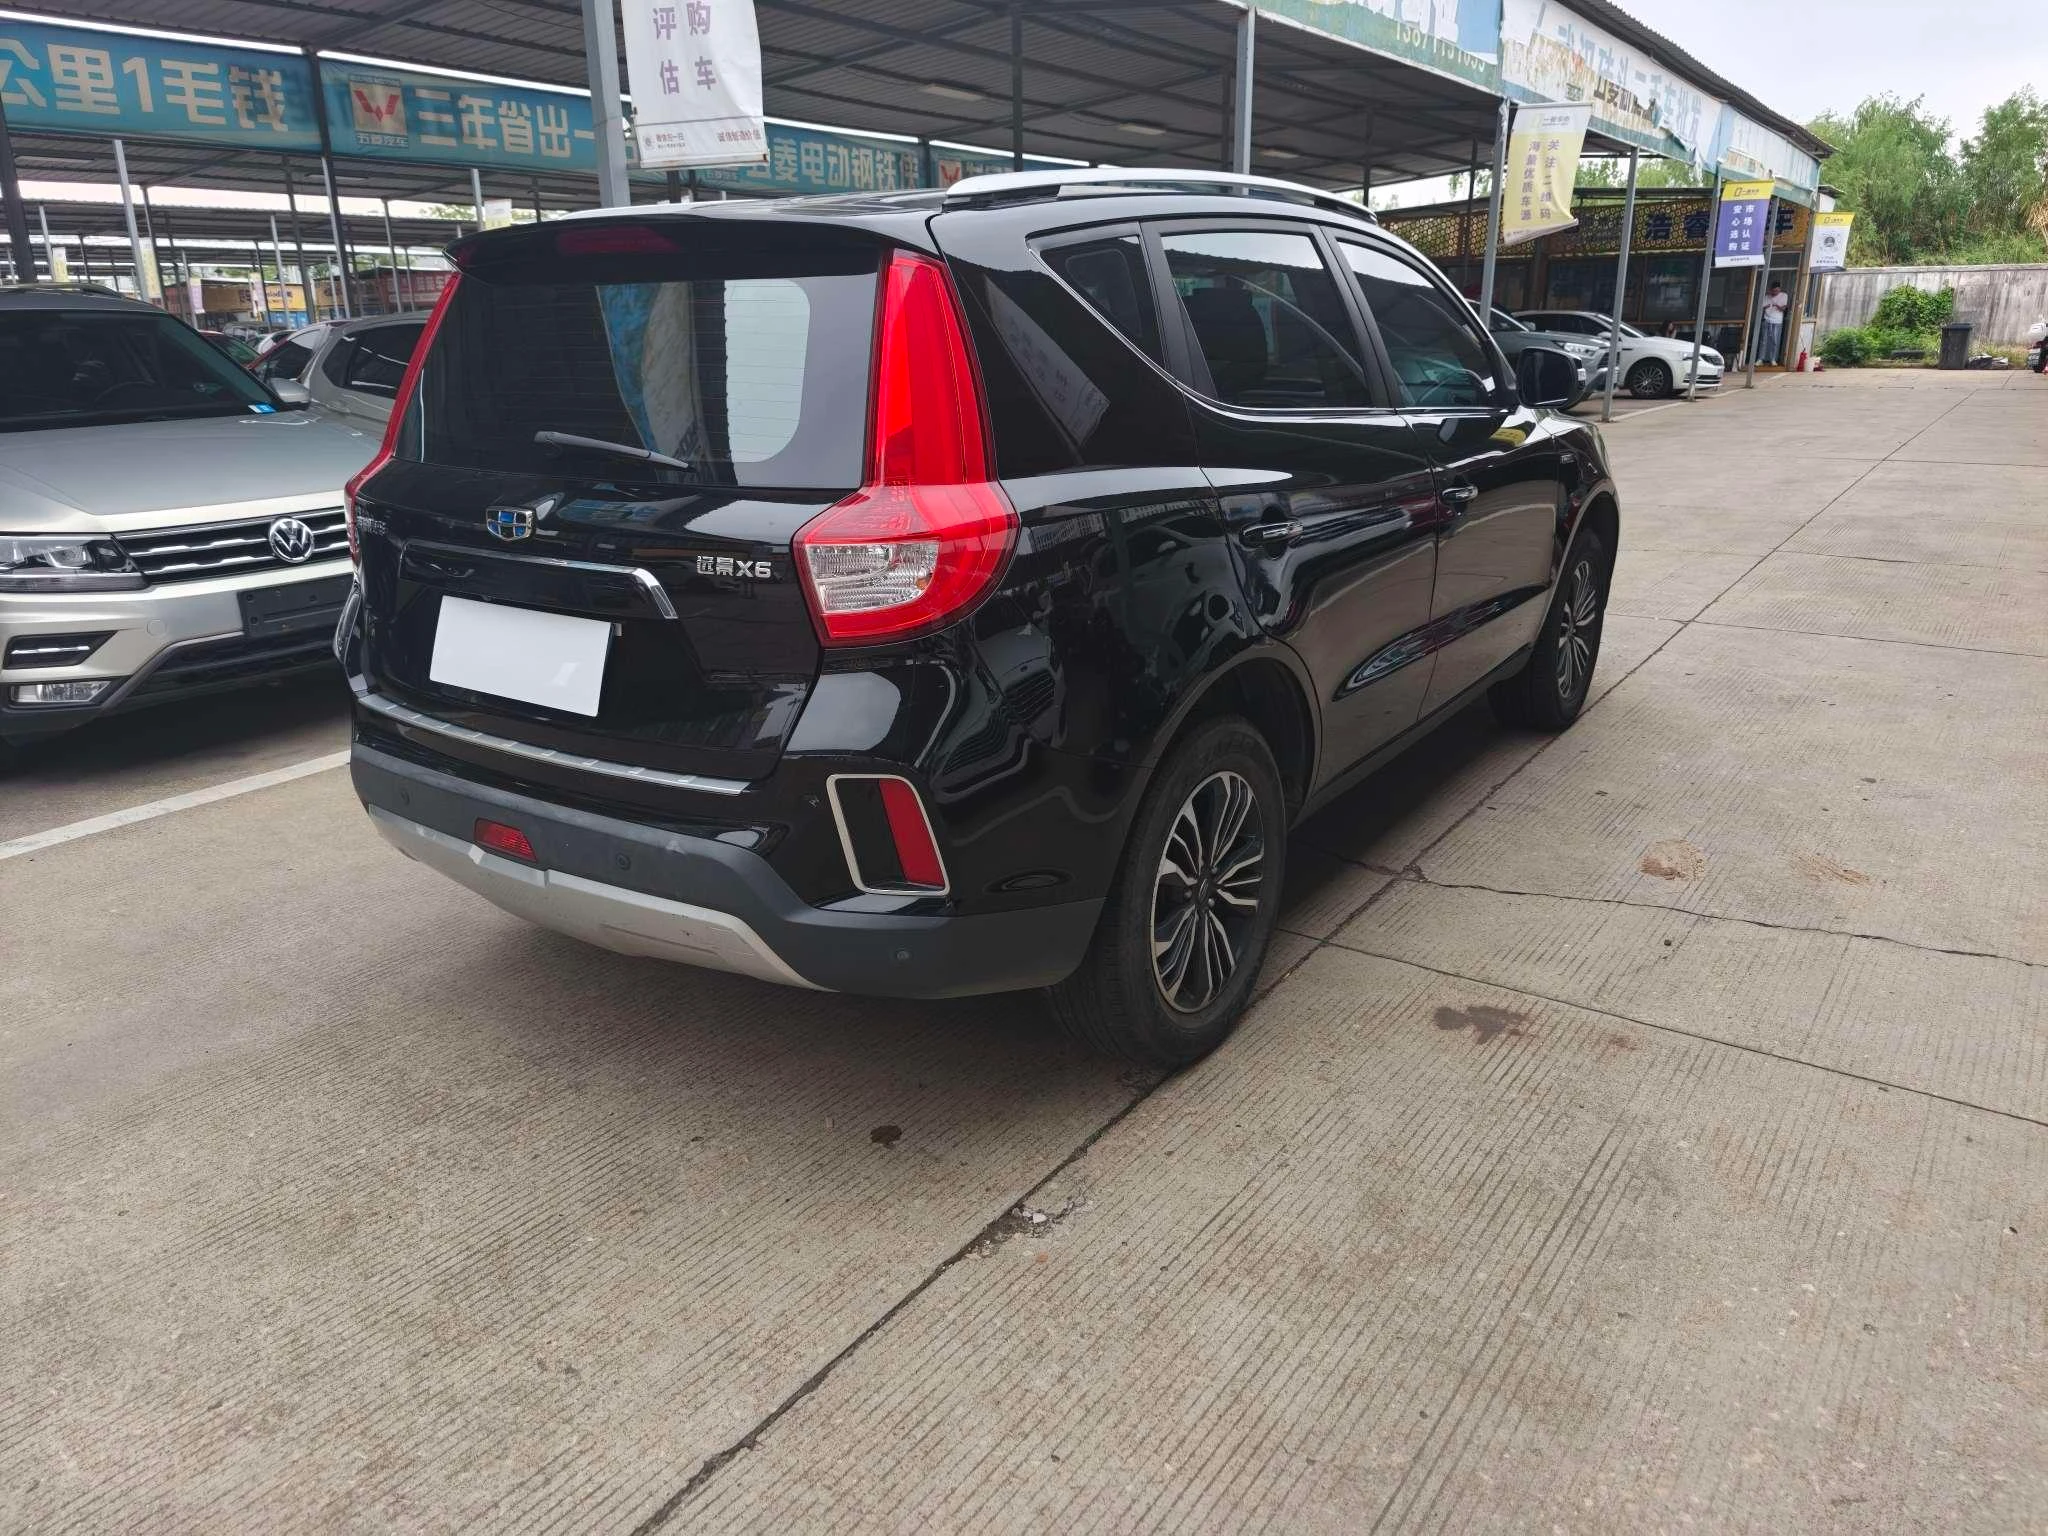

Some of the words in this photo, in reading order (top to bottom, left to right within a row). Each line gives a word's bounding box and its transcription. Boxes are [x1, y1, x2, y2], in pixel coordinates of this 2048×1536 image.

[652, 7, 681, 95] 评估
[414, 88, 640, 164] 三年省出一
[1540, 140, 1561, 220] 关注二维码
[1728, 205, 1743, 252] 安心选购
[1741, 204, 1756, 251] 市场认证
[696, 555, 773, 579] 远景X6
